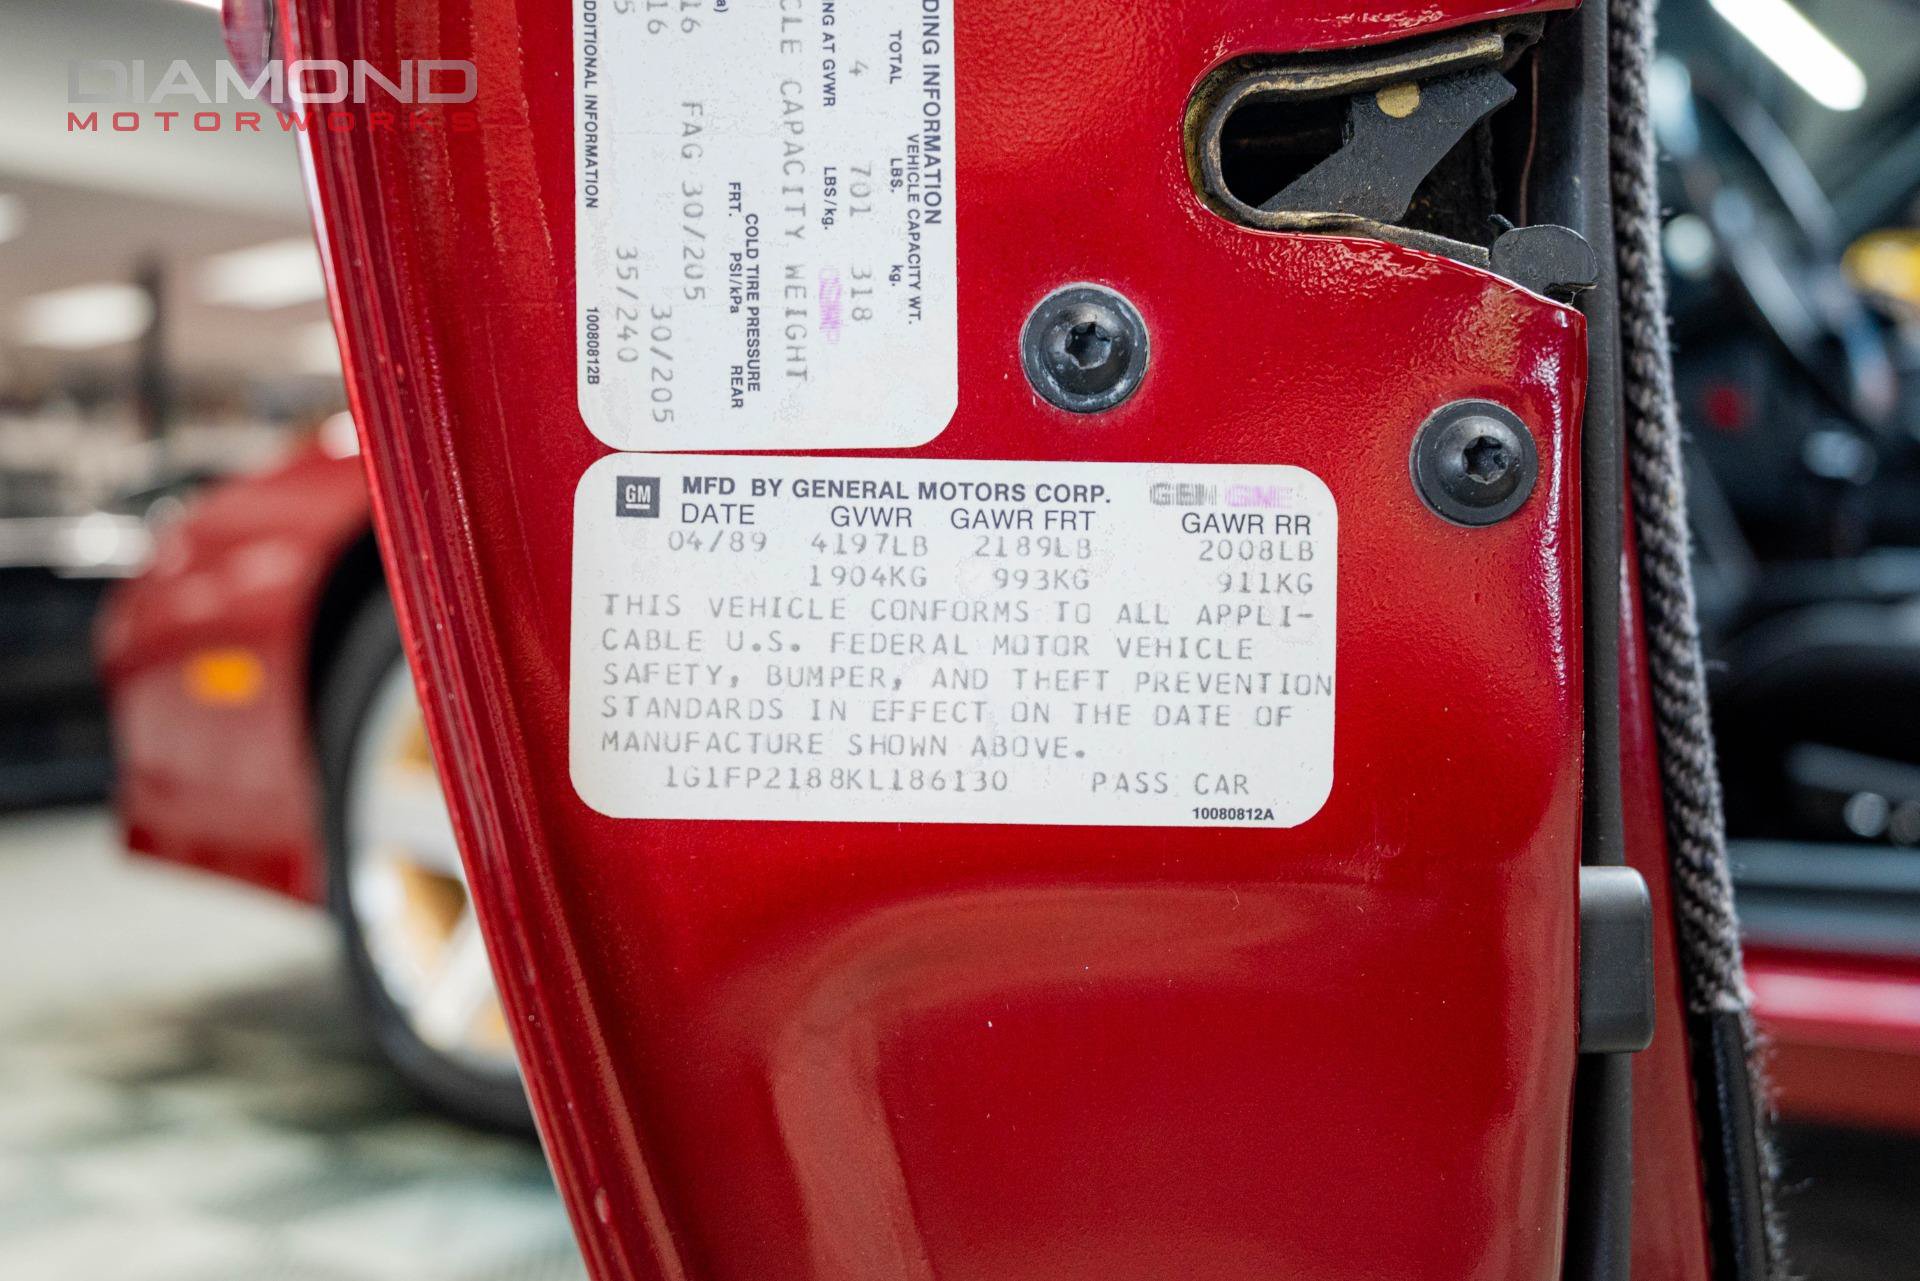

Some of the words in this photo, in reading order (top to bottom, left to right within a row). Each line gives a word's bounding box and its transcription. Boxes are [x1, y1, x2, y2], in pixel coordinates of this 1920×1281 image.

[822, 0, 835, 26] NG
[822, 31, 835, 54] AT
[888, 29, 903, 85] TOTAL
[822, 58, 836, 107] GVWR
[849, 60, 868, 76] 4
[681, 102, 703, 159] FAG
[923, 64, 942, 224] INFORMATION
[584, 94, 599, 209] INFORMATION
[780, 80, 806, 239] CAPACITY
[906, 133, 920, 203] VEHICLE
[849, 165, 871, 217] 701
[889, 158, 904, 194] LBS.
[728, 182, 742, 217] FRT.
[821, 166, 837, 230] LBS/kg.
[682, 181, 706, 300] 30/205
[744, 213, 759, 260] COLD
[906, 207, 922, 291] CAPACITY
[729, 252, 743, 314] PSI/kPa
[745, 264, 760, 301] TIRE
[851, 266, 873, 321] 318
[888, 264, 904, 286] kg.
[616, 248, 639, 362] 35/240
[784, 264, 808, 381] WEIGHT
[908, 296, 922, 325] WT.
[586, 307, 600, 385] 10080812B
[650, 305, 674, 423] 30/205
[746, 306, 760, 392] PRESSURE
[731, 365, 744, 409] REAR
[625, 484, 651, 504] GM
[681, 476, 735, 495] MFD
[751, 478, 784, 497] BY
[792, 478, 910, 500] GENERAL
[918, 481, 1026, 502] MOTORS
[1035, 483, 1111, 504] CORP.
[681, 502, 755, 525] DATE
[831, 505, 912, 528] GVWR
[950, 508, 1033, 530] GAWR
[1045, 510, 1096, 531] FRT
[1181, 512, 1264, 535] GAWR
[1275, 514, 1311, 536] RR
[668, 530, 767, 552] 04/89
[811, 533, 928, 557] 4197LB
[975, 535, 1092, 559] 2189LB
[1199, 539, 1314, 561] 2008LB
[810, 565, 927, 587] 1904KG
[992, 568, 1089, 590] 993KG
[1219, 571, 1313, 596] 911KG
[605, 594, 680, 616] THIS
[709, 596, 845, 620] VEHICLE
[871, 598, 1029, 623] CONFORMS
[1058, 601, 1090, 624] TO
[1116, 602, 1169, 625] ALL
[1196, 604, 1313, 628] APPLI-
[602, 628, 702, 652] CABLE
[727, 630, 800, 652] U.S.
[831, 632, 968, 655] FEDERAL
[993, 634, 1089, 656] MOTOR
[1117, 636, 1252, 660] VEHICLE
[604, 663, 739, 688] SAFETY,
[767, 664, 902, 691] BUMPER,
[932, 667, 988, 690] AND
[1013, 668, 1109, 691] THEFT
[1136, 672, 1331, 696] PREVENTION
[602, 696, 783, 720] STANDARDS
[812, 699, 846, 721] IN
[872, 700, 987, 723] EFFECT
[1011, 702, 1049, 724] ON
[1074, 703, 1130, 726] THE
[1154, 704, 1230, 726] DATE
[1256, 705, 1292, 727] OF
[602, 731, 822, 755] MANUFACTURE
[848, 734, 946, 757] SHOWN
[971, 736, 1085, 759] ABOVE.
[667, 766, 1007, 792] 1G1FP2188KL186130
[1092, 772, 1168, 794] PASS
[1194, 773, 1249, 795] CAR
[1192, 807, 1275, 821] 10080812A
